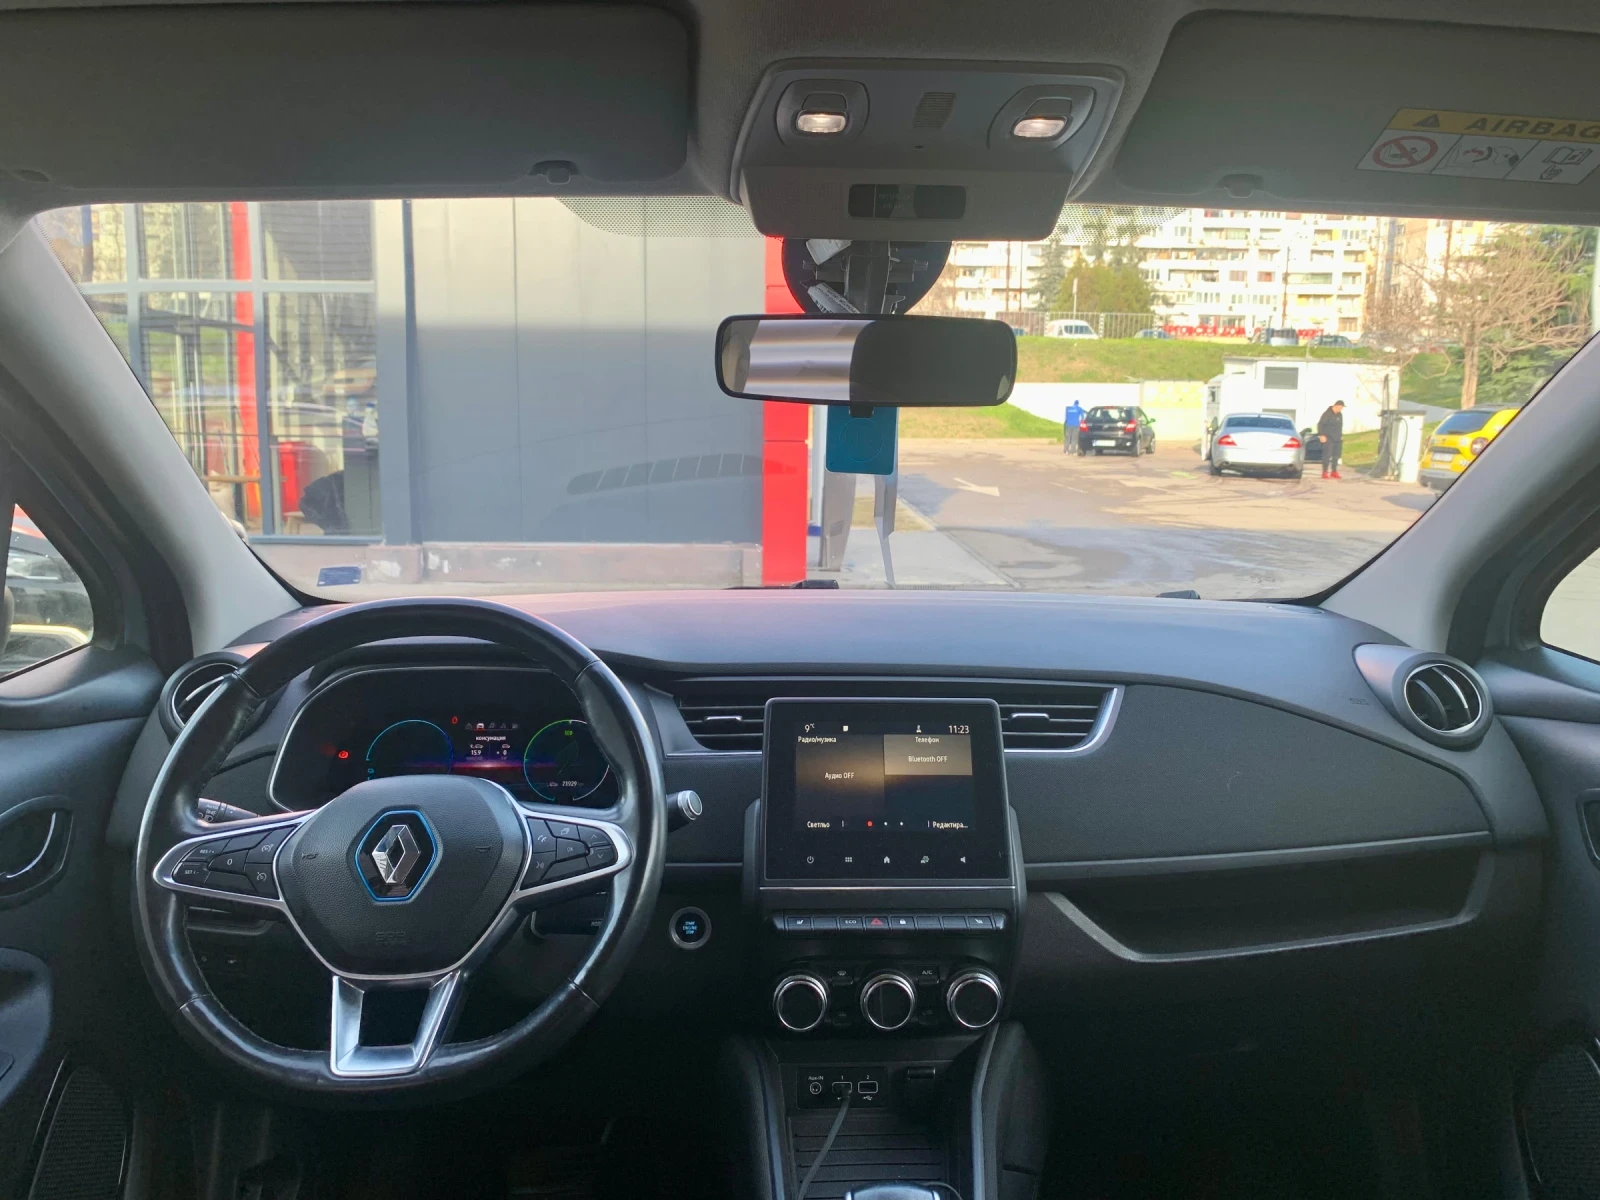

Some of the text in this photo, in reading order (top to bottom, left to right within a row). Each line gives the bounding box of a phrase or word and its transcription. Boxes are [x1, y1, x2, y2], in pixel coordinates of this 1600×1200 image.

[1463, 116, 1600, 138] AIRBAG
[948, 725, 970, 734] 11:23
[915, 736, 939, 744] Телефон
[908, 755, 948, 763] Bluetooth OFF
[824, 772, 842, 781] Аудио
